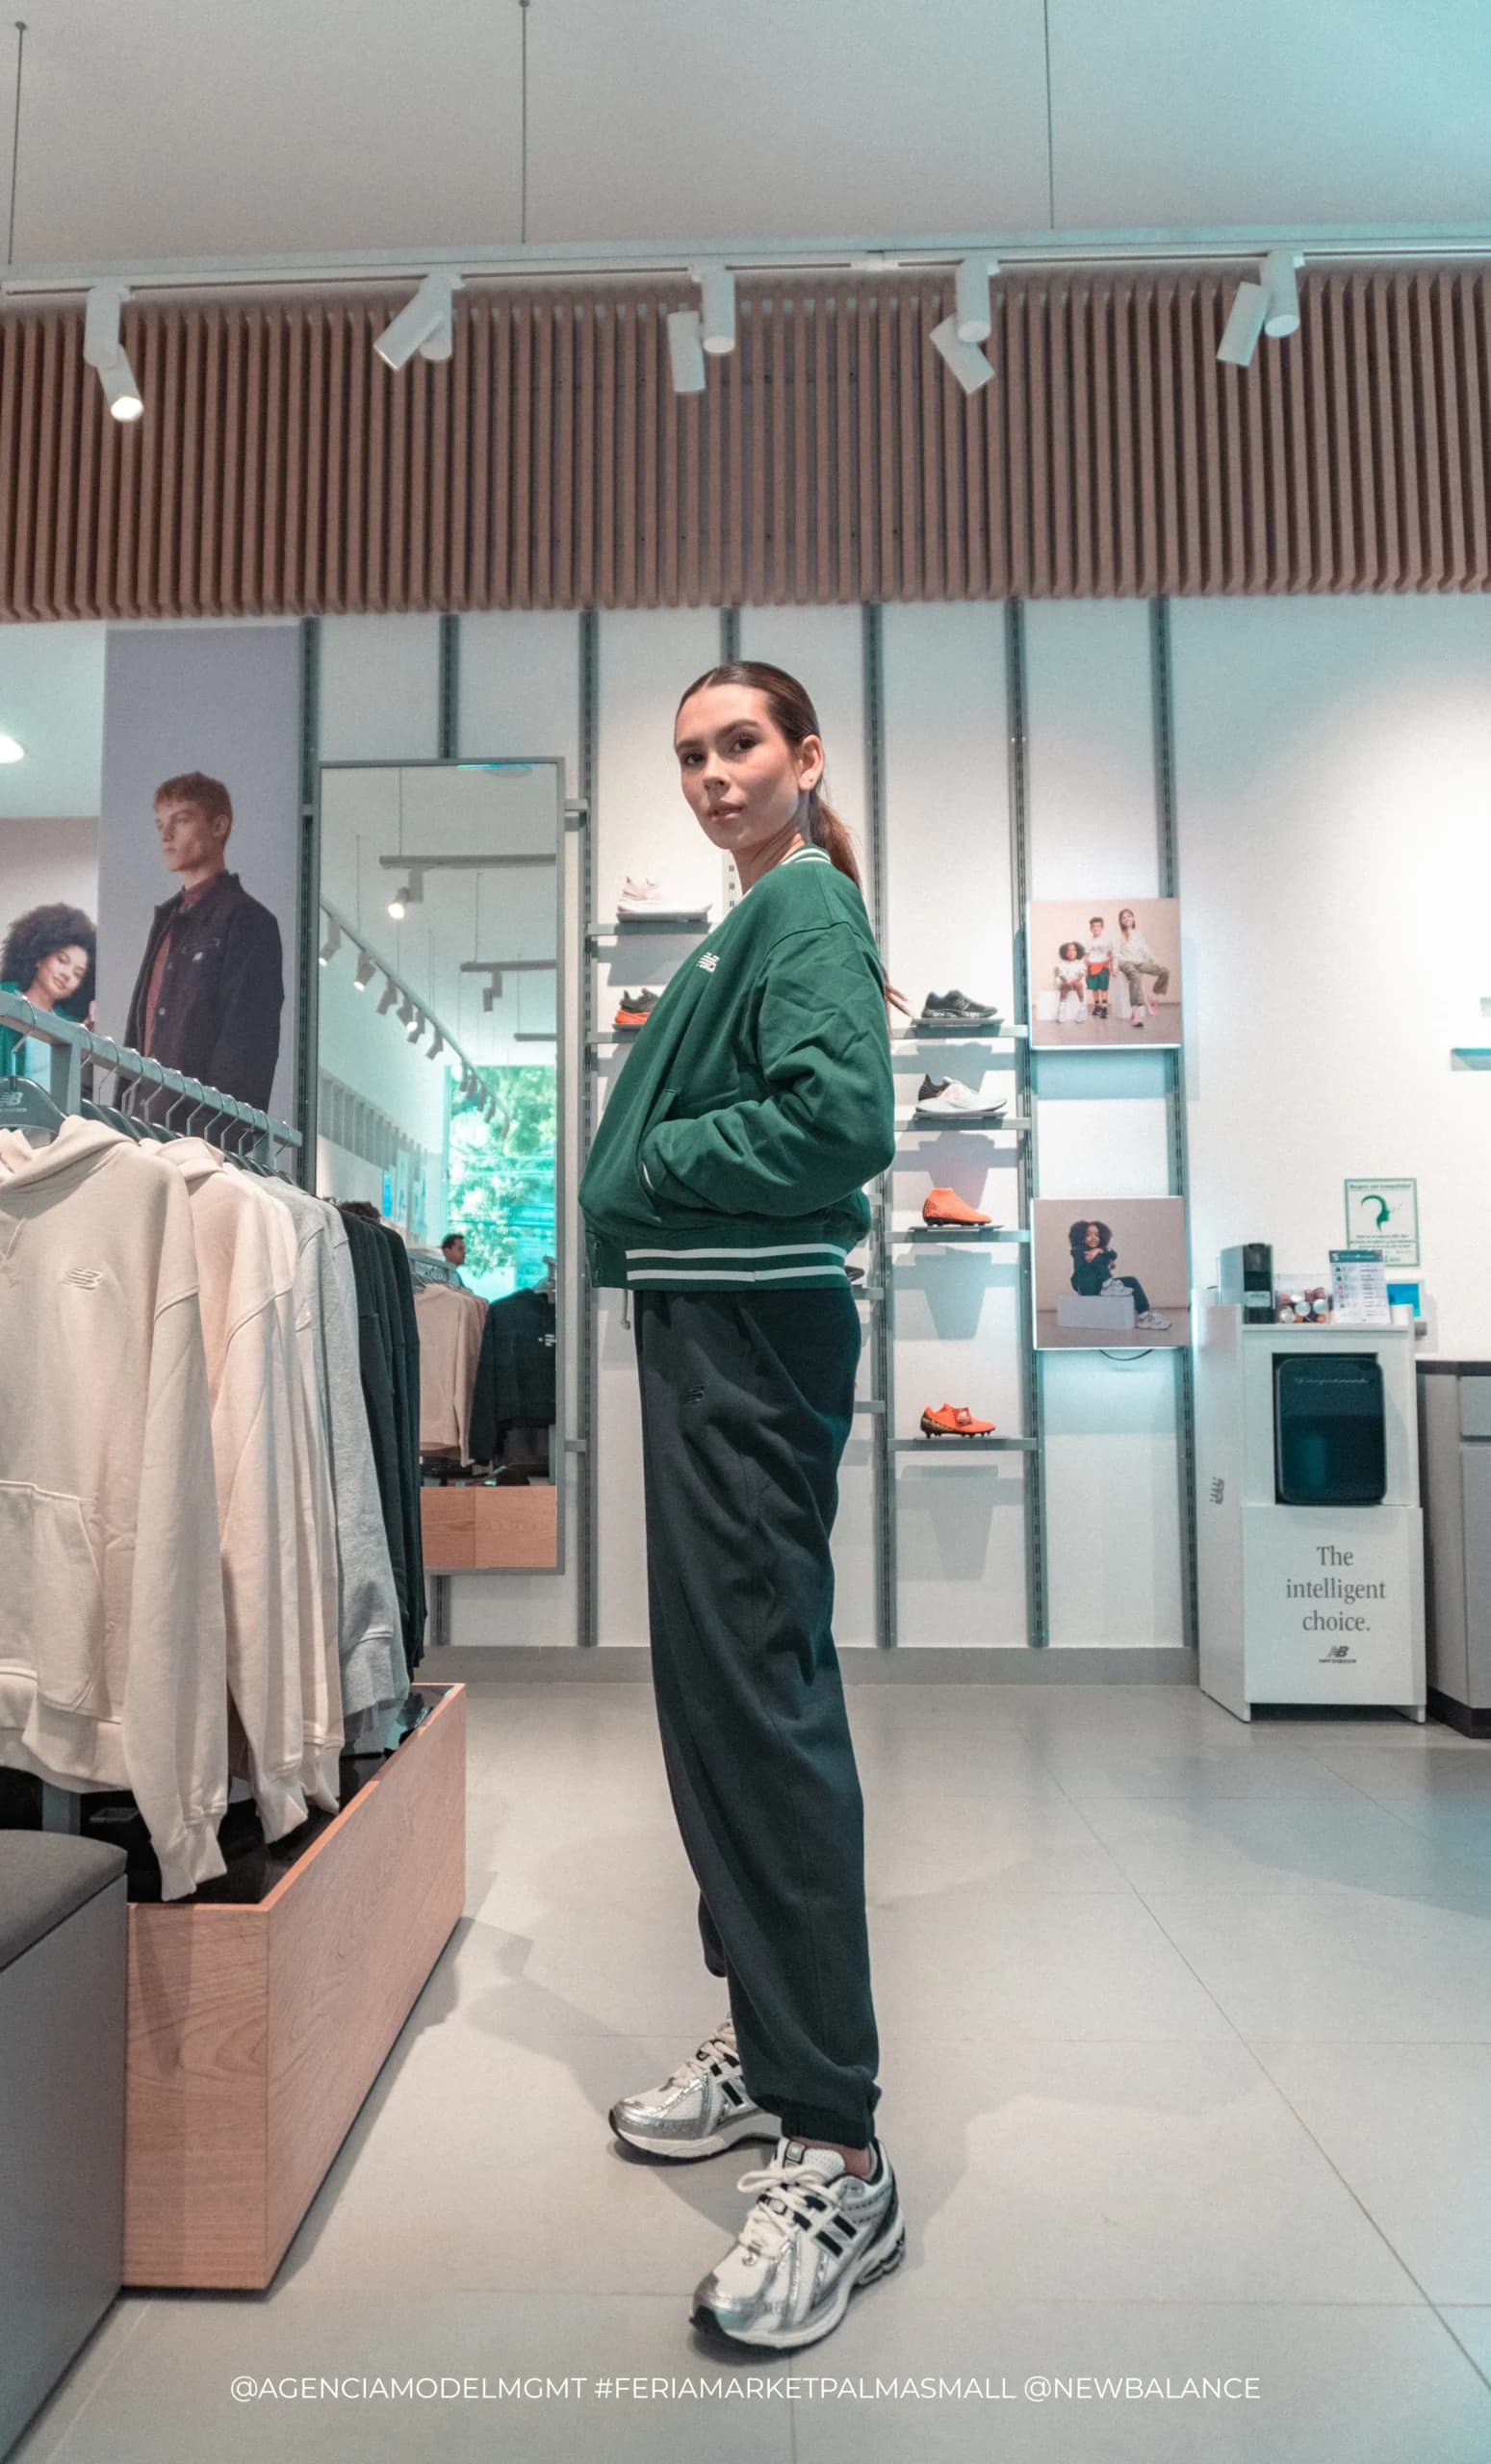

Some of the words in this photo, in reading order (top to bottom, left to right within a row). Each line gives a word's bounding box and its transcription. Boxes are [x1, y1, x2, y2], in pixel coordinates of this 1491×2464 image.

[1317, 1545, 1354, 1566] The
[1286, 1578, 1386, 1604] intelligent
[1302, 1609, 1371, 1631] choice.
